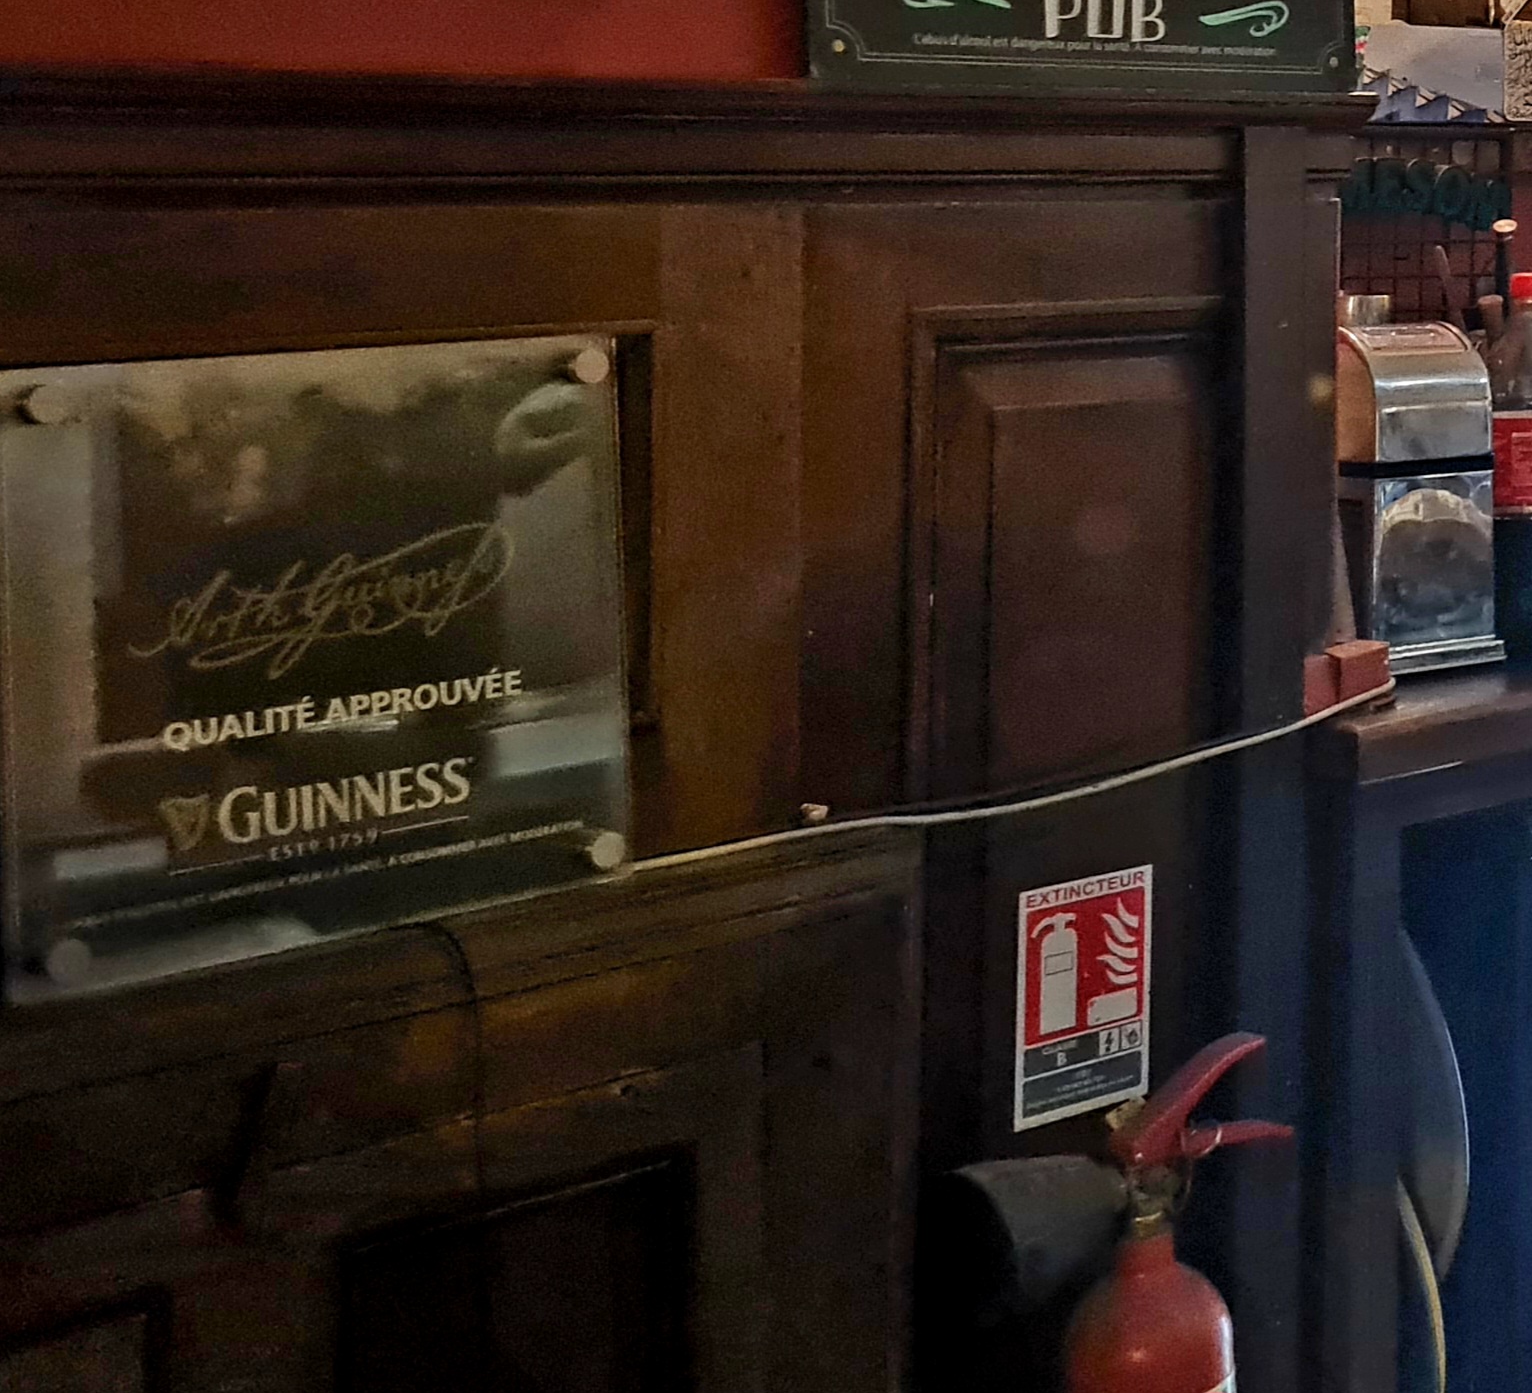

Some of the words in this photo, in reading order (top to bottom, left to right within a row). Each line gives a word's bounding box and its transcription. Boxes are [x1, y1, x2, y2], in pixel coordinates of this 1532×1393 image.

[162, 695, 317, 752] QUALITÉ
[328, 668, 524, 727] APPROUVÉE
[218, 757, 473, 845] GUINNESS
[328, 829, 379, 851] 1759
[1026, 869, 1145, 909] EXTINCTEUR
